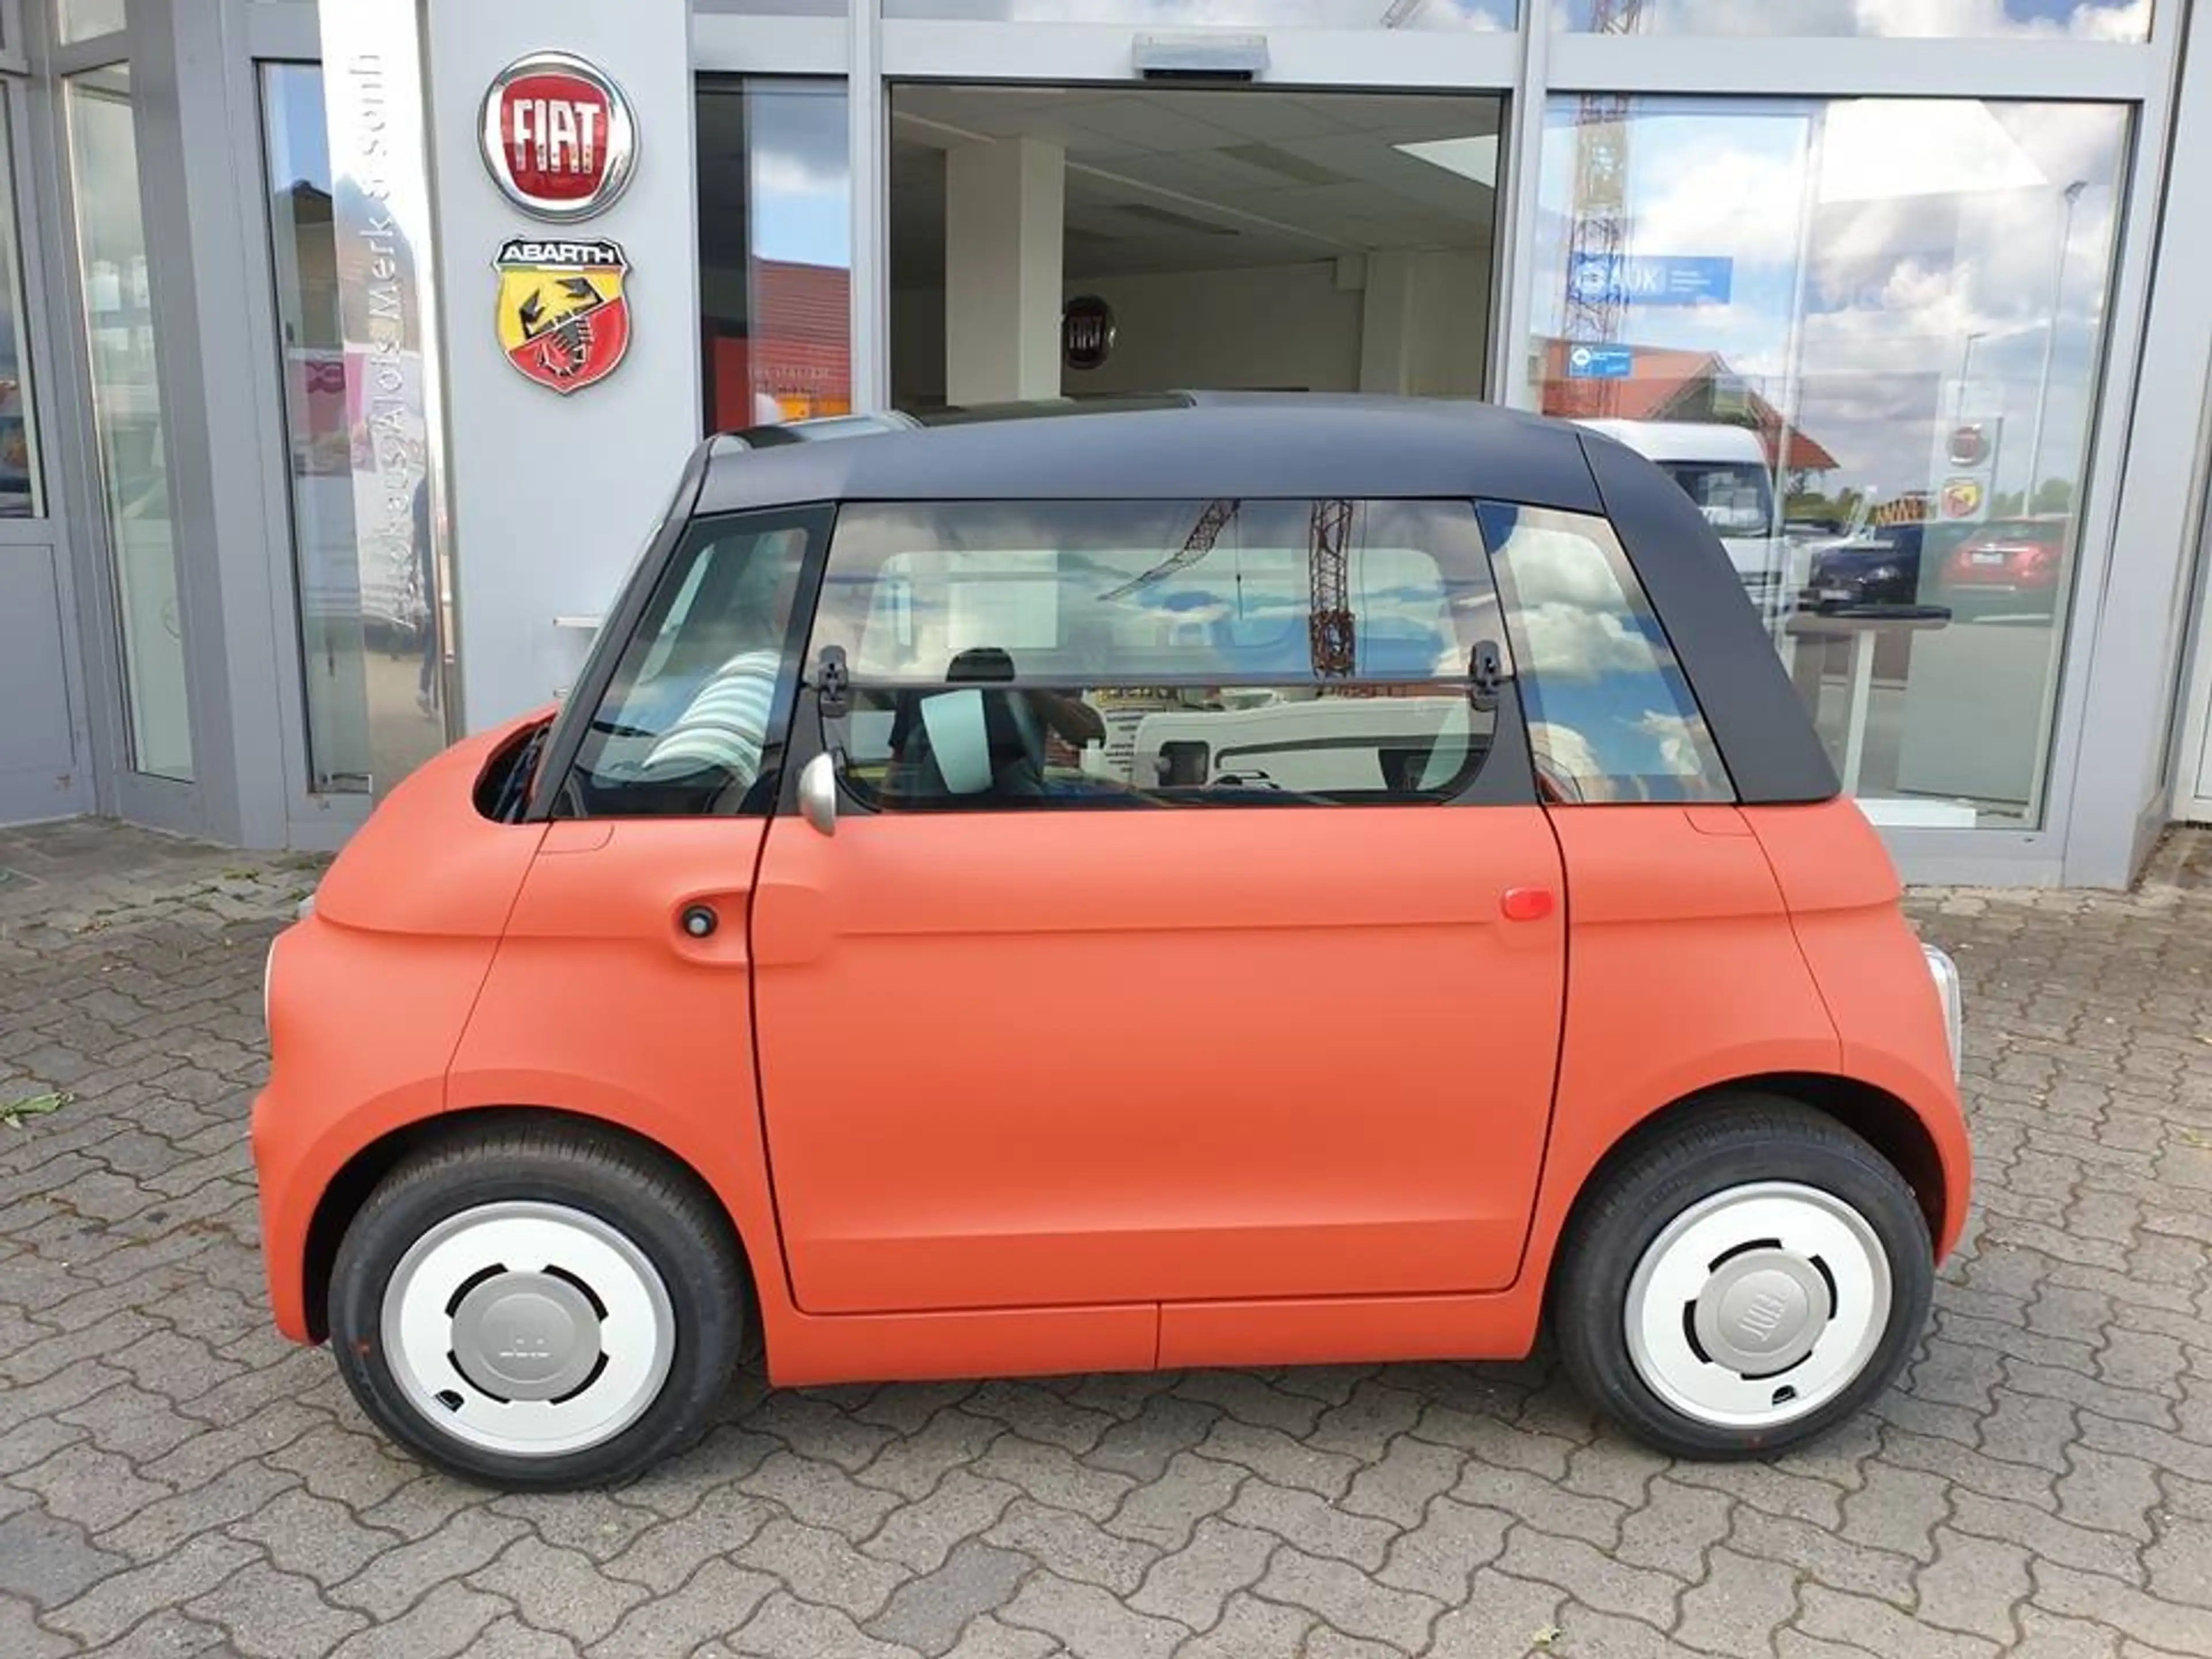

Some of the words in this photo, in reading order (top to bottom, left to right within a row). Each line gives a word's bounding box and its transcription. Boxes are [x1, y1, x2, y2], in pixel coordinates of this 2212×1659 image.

[513, 99, 601, 175] FIAT
[358, 217, 402, 319] Merk
[503, 243, 615, 263] ABARTH
